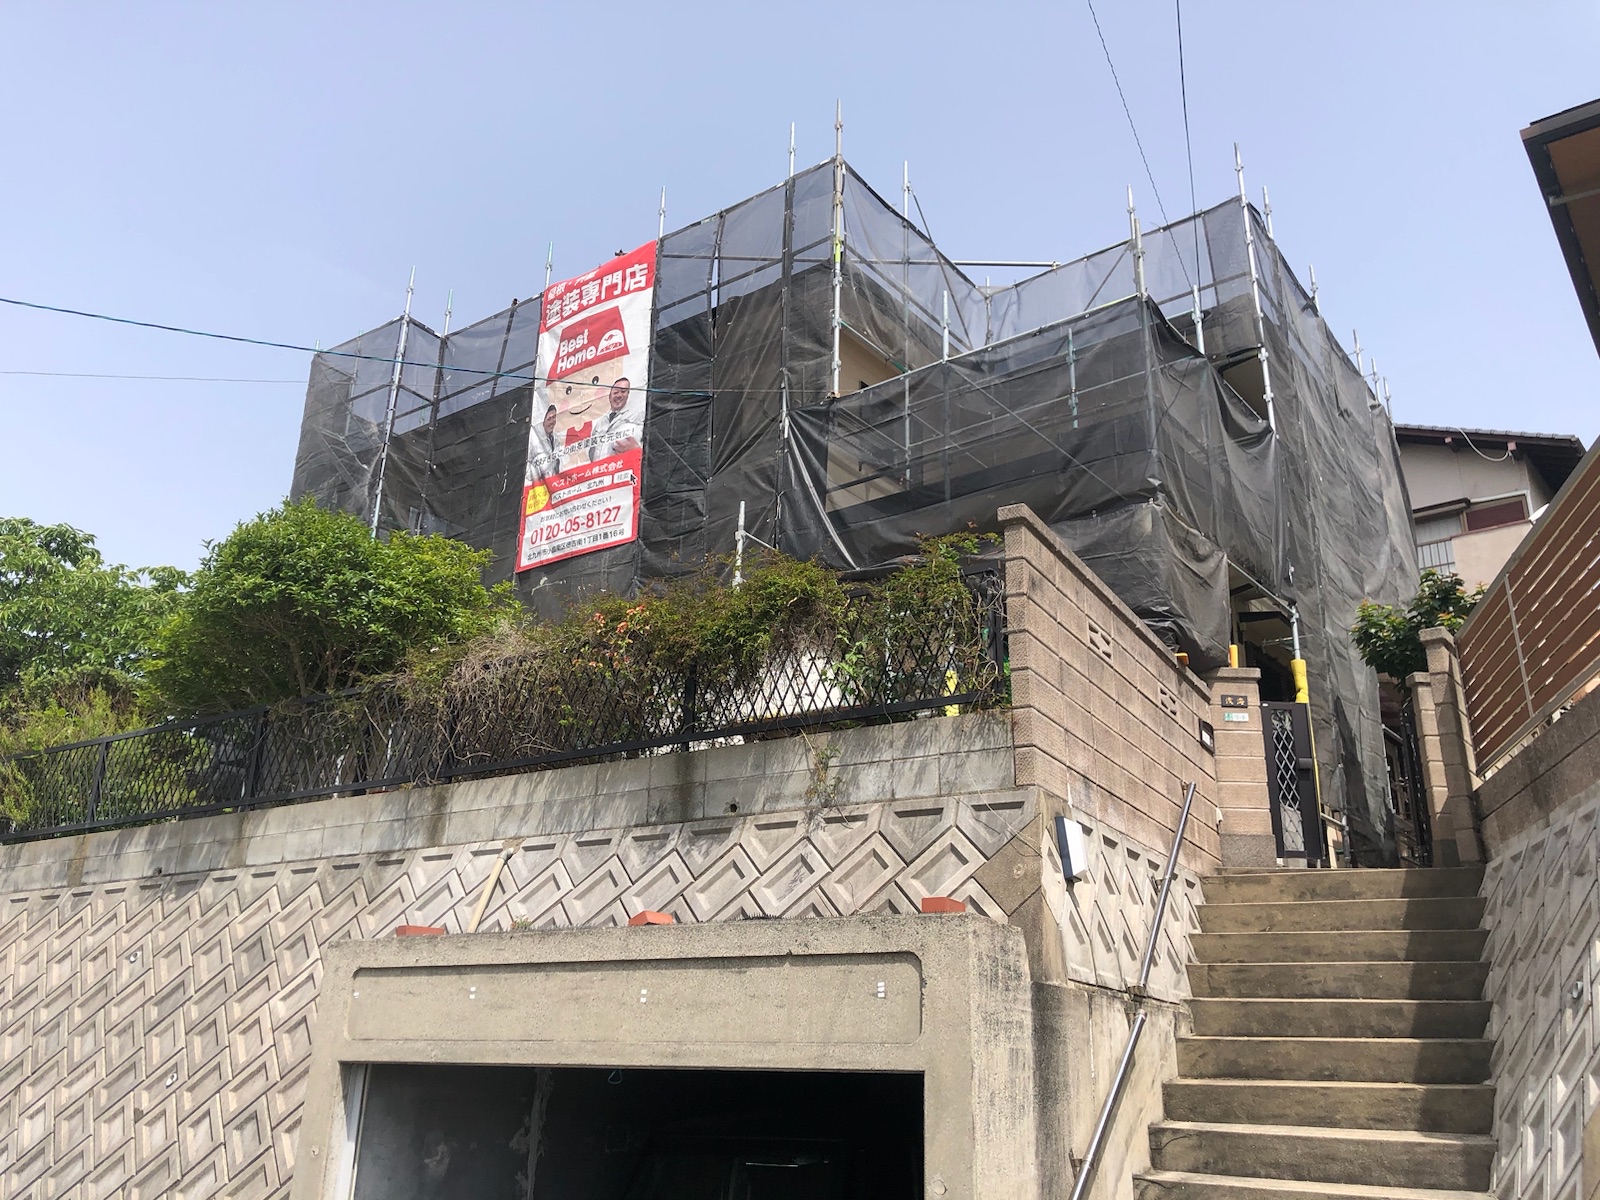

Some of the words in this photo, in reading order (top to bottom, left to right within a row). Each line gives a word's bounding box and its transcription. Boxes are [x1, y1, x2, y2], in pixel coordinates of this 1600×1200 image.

[546, 263, 649, 327] 塗装専門店
[559, 328, 589, 357] Best
[556, 346, 597, 374] Home
[551, 460, 624, 487] ベストホーム株式会社
[552, 486, 582, 501] ベストホーム
[586, 478, 605, 490] 北九州
[530, 506, 622, 545] 0120-05-8127
